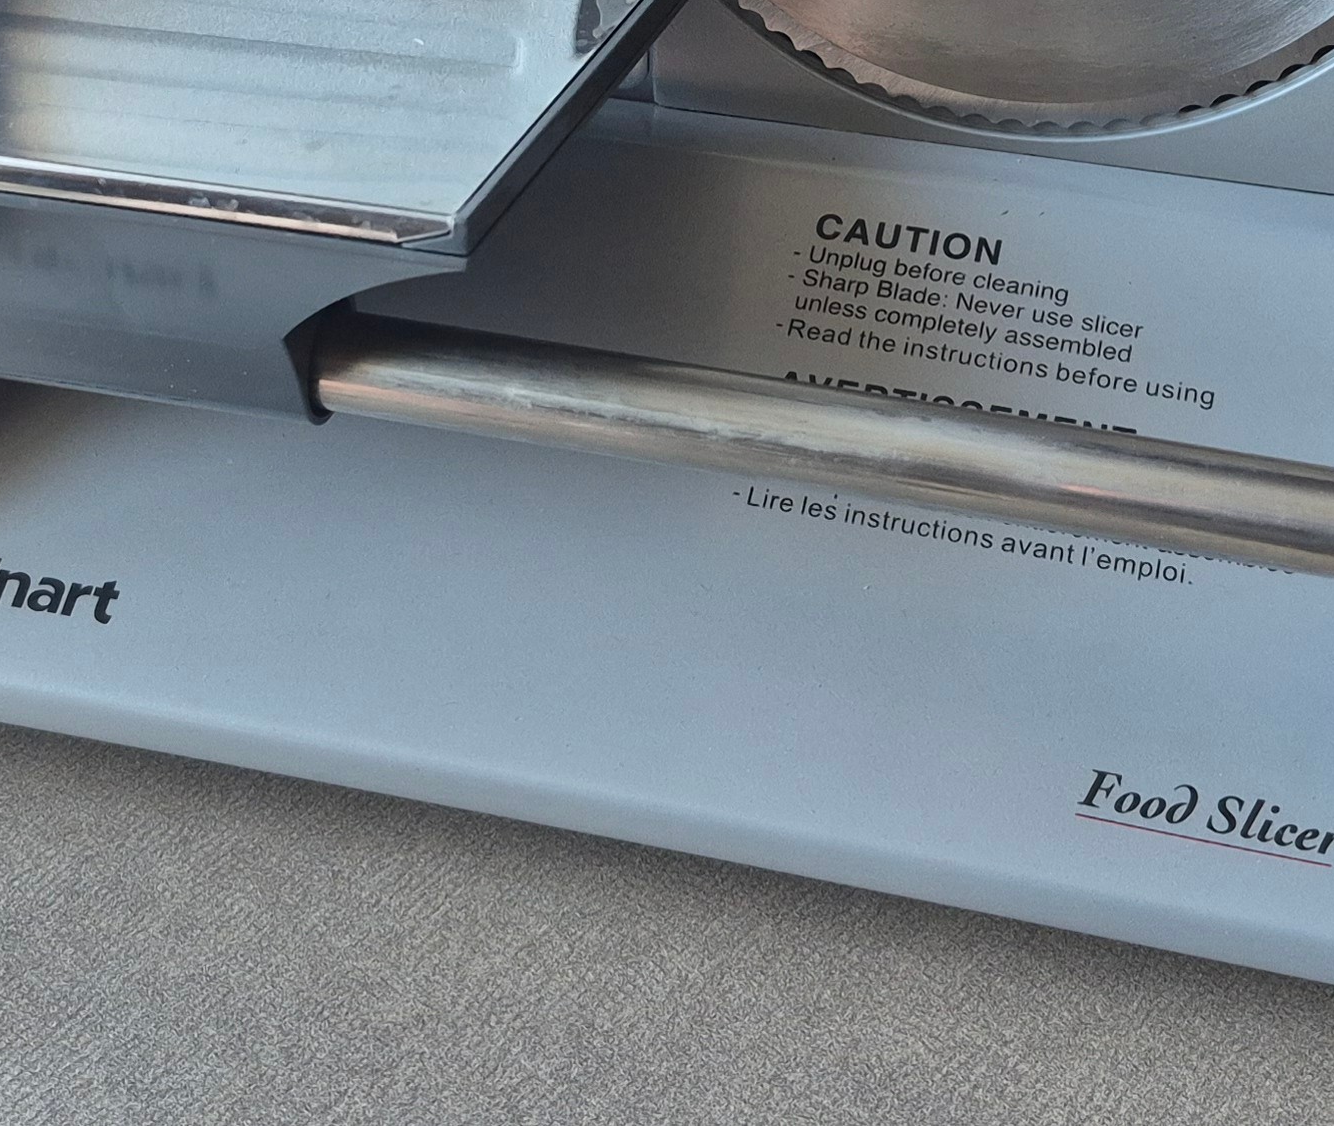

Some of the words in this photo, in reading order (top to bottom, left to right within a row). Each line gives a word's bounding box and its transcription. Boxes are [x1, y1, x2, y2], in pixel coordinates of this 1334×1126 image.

[815, 213, 1003, 266] CAUTION
[802, 268, 869, 298] Sharp
[876, 279, 948, 308] Blade:
[955, 291, 1025, 320] Never
[1032, 307, 1074, 328] use
[1080, 314, 1144, 339] slicer
[808, 244, 887, 277] Unplug
[893, 258, 966, 286] before
[972, 272, 1069, 307] cleaning
[794, 294, 868, 320] unless
[873, 307, 998, 345] completely
[1003, 328, 1134, 363] assembled
[787, 317, 853, 347] Read
[858, 329, 897, 353] the
[902, 336, 1049, 379] instructions
[1055, 362, 1138, 394] before
[1145, 381, 1216, 411] using
[746, 485, 795, 513] Lire
[800, 495, 838, 521] les
[843, 502, 994, 550] instructions
[1000, 535, 1075, 566] avant
[1081, 545, 1194, 585] l'emploi.
[1076, 768, 1200, 825] Food
